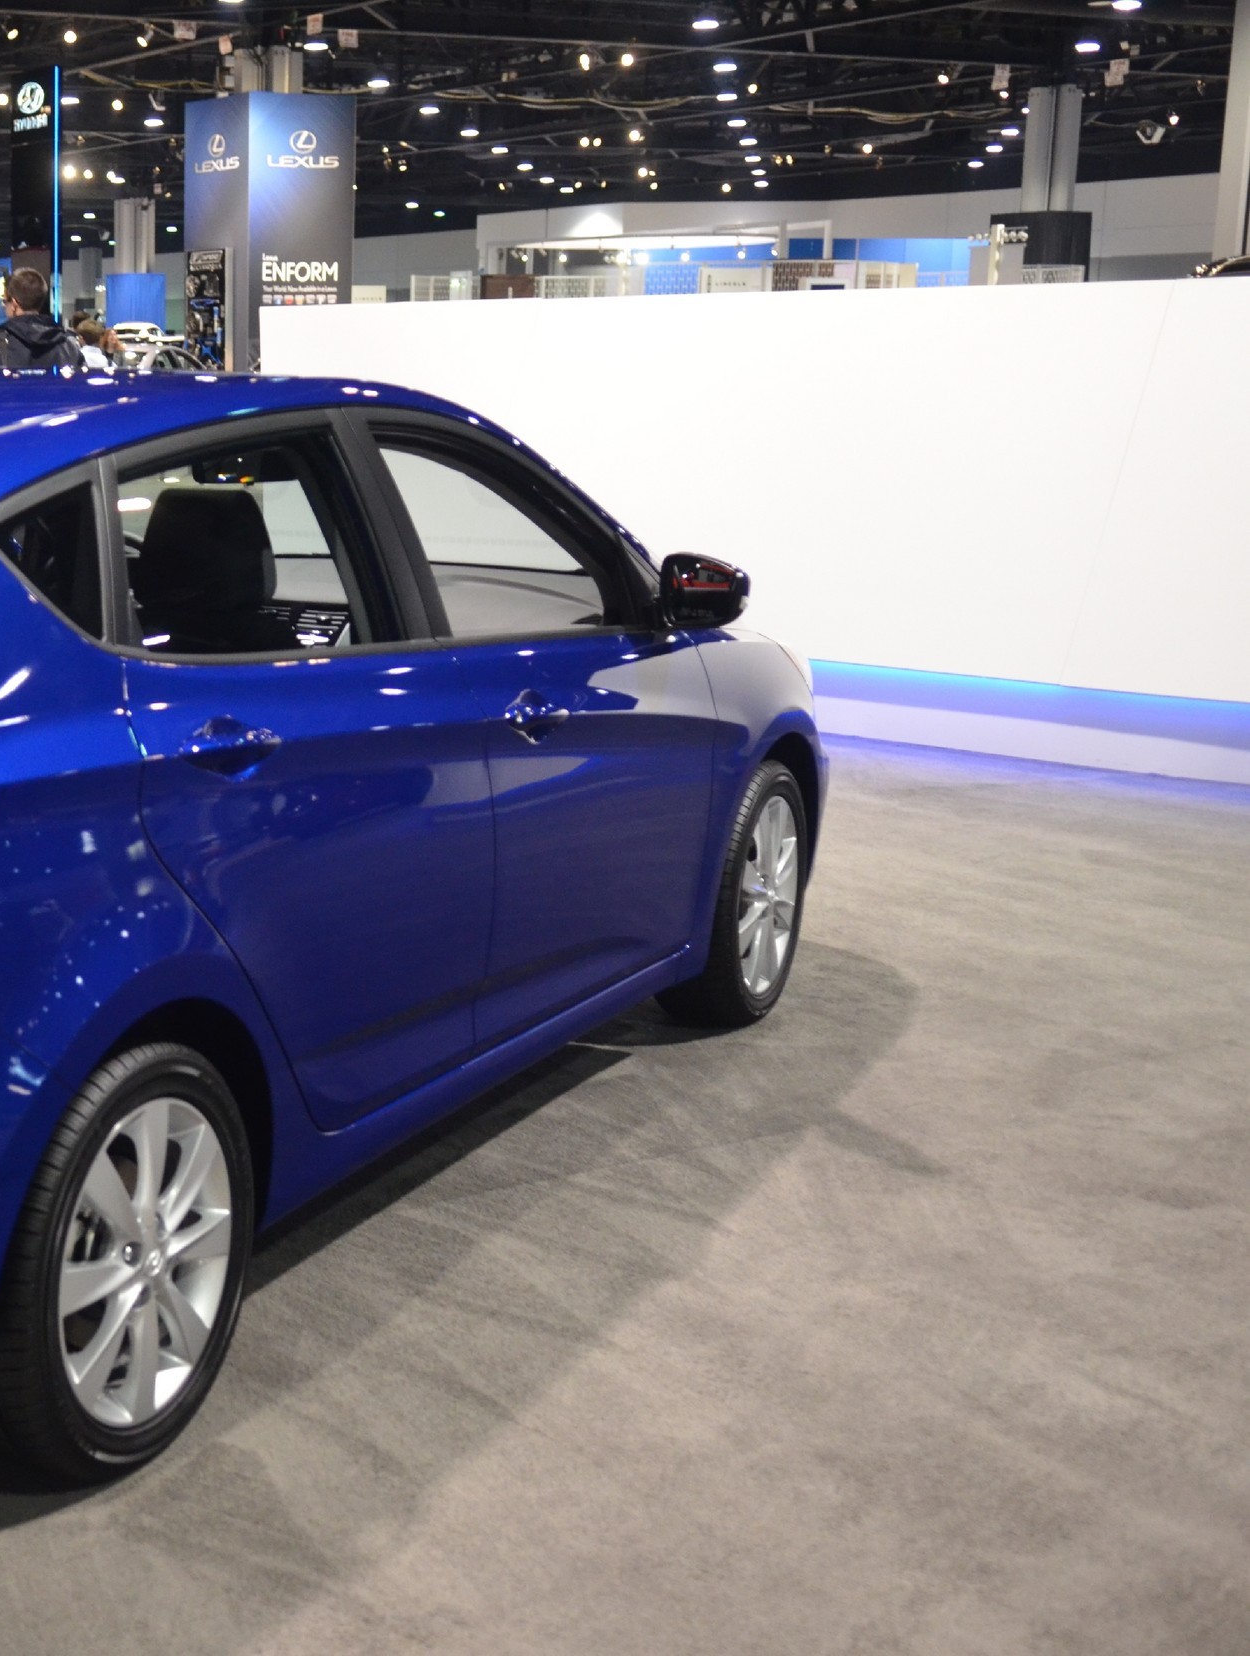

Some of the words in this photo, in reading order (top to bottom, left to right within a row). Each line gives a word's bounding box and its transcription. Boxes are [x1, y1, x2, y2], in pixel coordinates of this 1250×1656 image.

[194, 156, 240, 174] LEXUS
[267, 154, 340, 169] LEXUS
[262, 261, 339, 282] ENFORM
